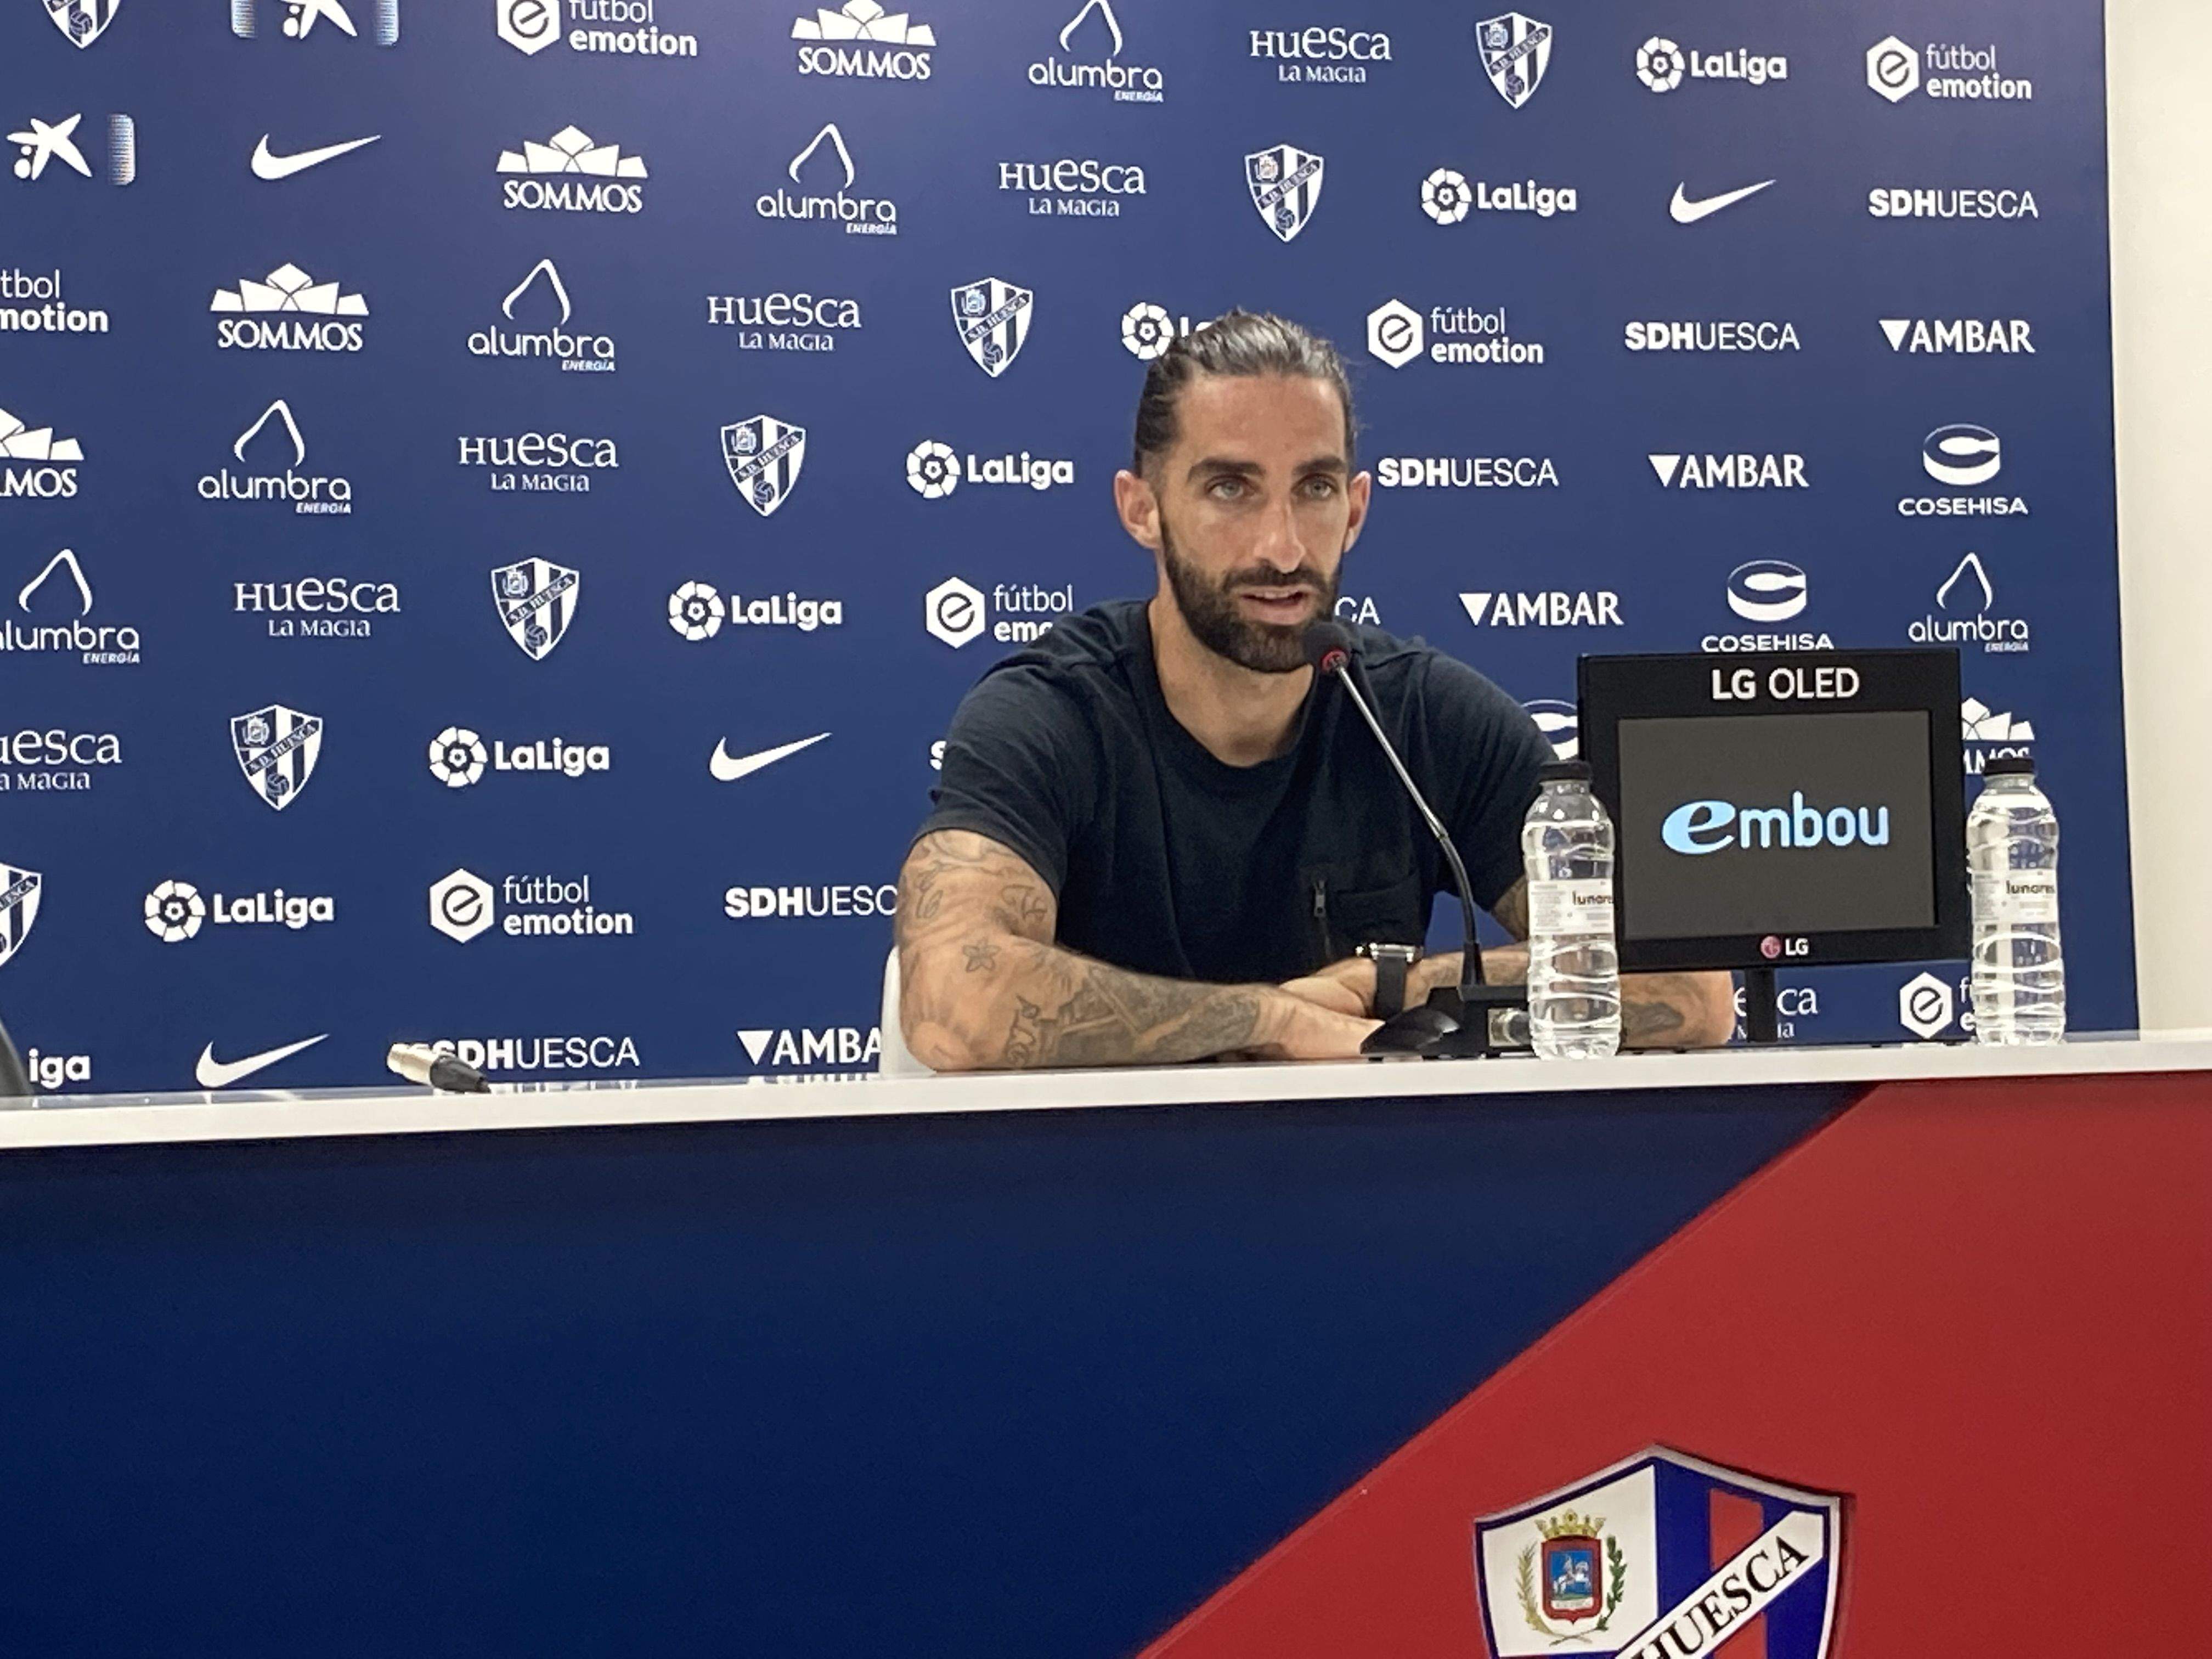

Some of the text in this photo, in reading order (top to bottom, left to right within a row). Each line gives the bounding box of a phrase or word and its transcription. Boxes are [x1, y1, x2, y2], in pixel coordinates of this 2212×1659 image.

[569, 26, 697, 56] emotion
[799, 47, 930, 79] SOMMOS
[1691, 48, 1787, 84] LaLiga
[1926, 44, 1995, 70] fútbol
[1029, 57, 1162, 89] alumbra
[1927, 72, 2031, 99] emotion
[504, 180, 642, 213] SOMMOS
[757, 189, 895, 222] alumbra
[1478, 180, 1576, 217] LaLiga
[1869, 189, 2038, 218] SDHUESCA
[0, 269, 59, 298] tbol
[0, 302, 108, 332] motion
[1431, 307, 1505, 334] fútbol
[218, 320, 362, 351] SOMMOS
[469, 325, 614, 358] alumbra
[1431, 337, 1543, 363] emotion
[1626, 322, 1800, 350] SDHUESCA
[1910, 320, 2035, 353] AMBAR
[0, 468, 77, 496] MOS
[198, 469, 351, 500] alumbra
[968, 452, 1073, 490] LaLiga
[1378, 458, 1559, 486] SDHUESCA
[1680, 455, 1809, 488] AMBAR
[1899, 498, 2028, 515] COSEHISA
[731, 592, 842, 630] LaLiga
[994, 584, 1073, 612] fútbol
[1491, 592, 1623, 625] AMBAR
[1701, 634, 1834, 652] COSEHISA
[1909, 614, 2028, 642] alumbra
[1713, 668, 1859, 699] LG OLED
[495, 738, 609, 776] LaLiga
[1662, 791, 1888, 854] embou
[503, 875, 589, 904] fútbol
[725, 885, 898, 917] SDHUESC
[214, 889, 334, 928] LaLiga
[504, 906, 633, 935] emotion
[1786, 939, 1808, 955] LG
[772, 1028, 881, 1064] AMBA
[29, 1049, 90, 1088] iga
[1630, 1535, 1809, 1659] HUESCA
